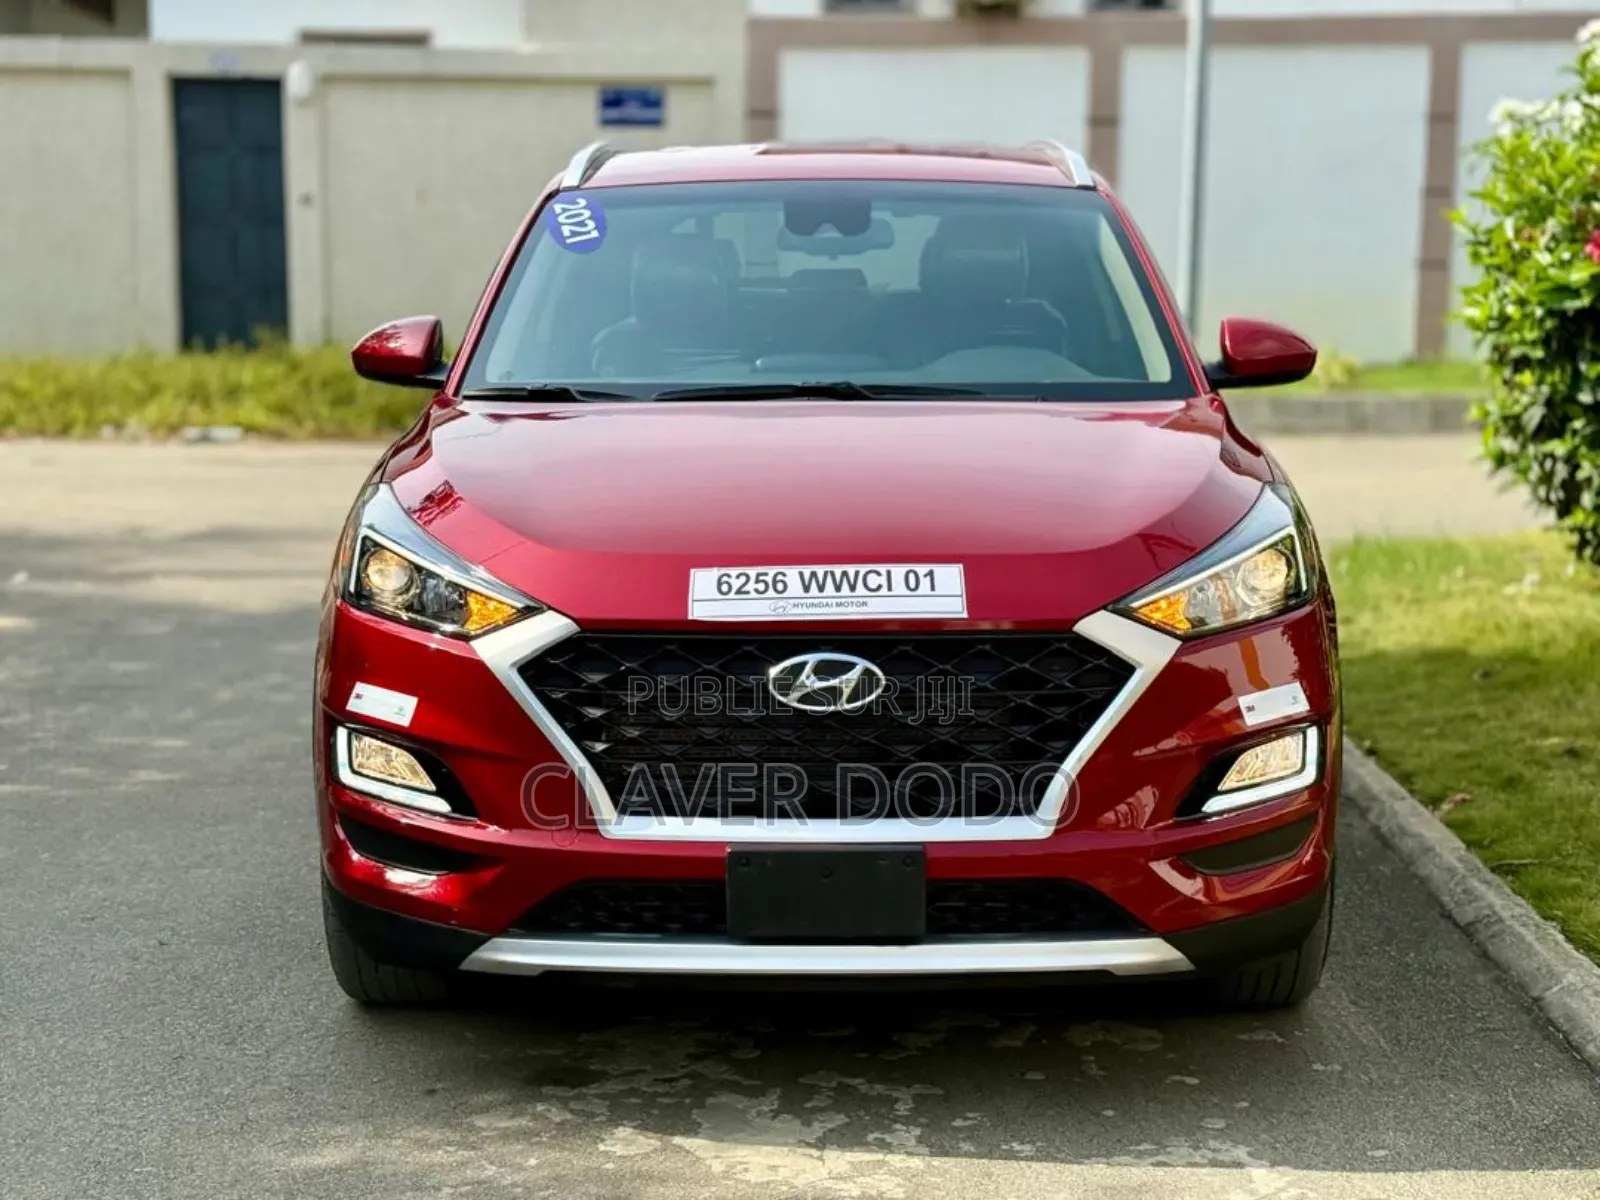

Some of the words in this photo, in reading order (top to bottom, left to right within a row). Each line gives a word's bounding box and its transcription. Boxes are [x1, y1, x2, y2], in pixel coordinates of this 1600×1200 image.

[552, 197, 600, 244] 2021
[716, 571, 788, 596] 6256
[798, 568, 893, 593] WWCI
[904, 568, 936, 592] 01
[792, 600, 834, 609] HYUNDAI
[835, 600, 868, 608] MOTOR
